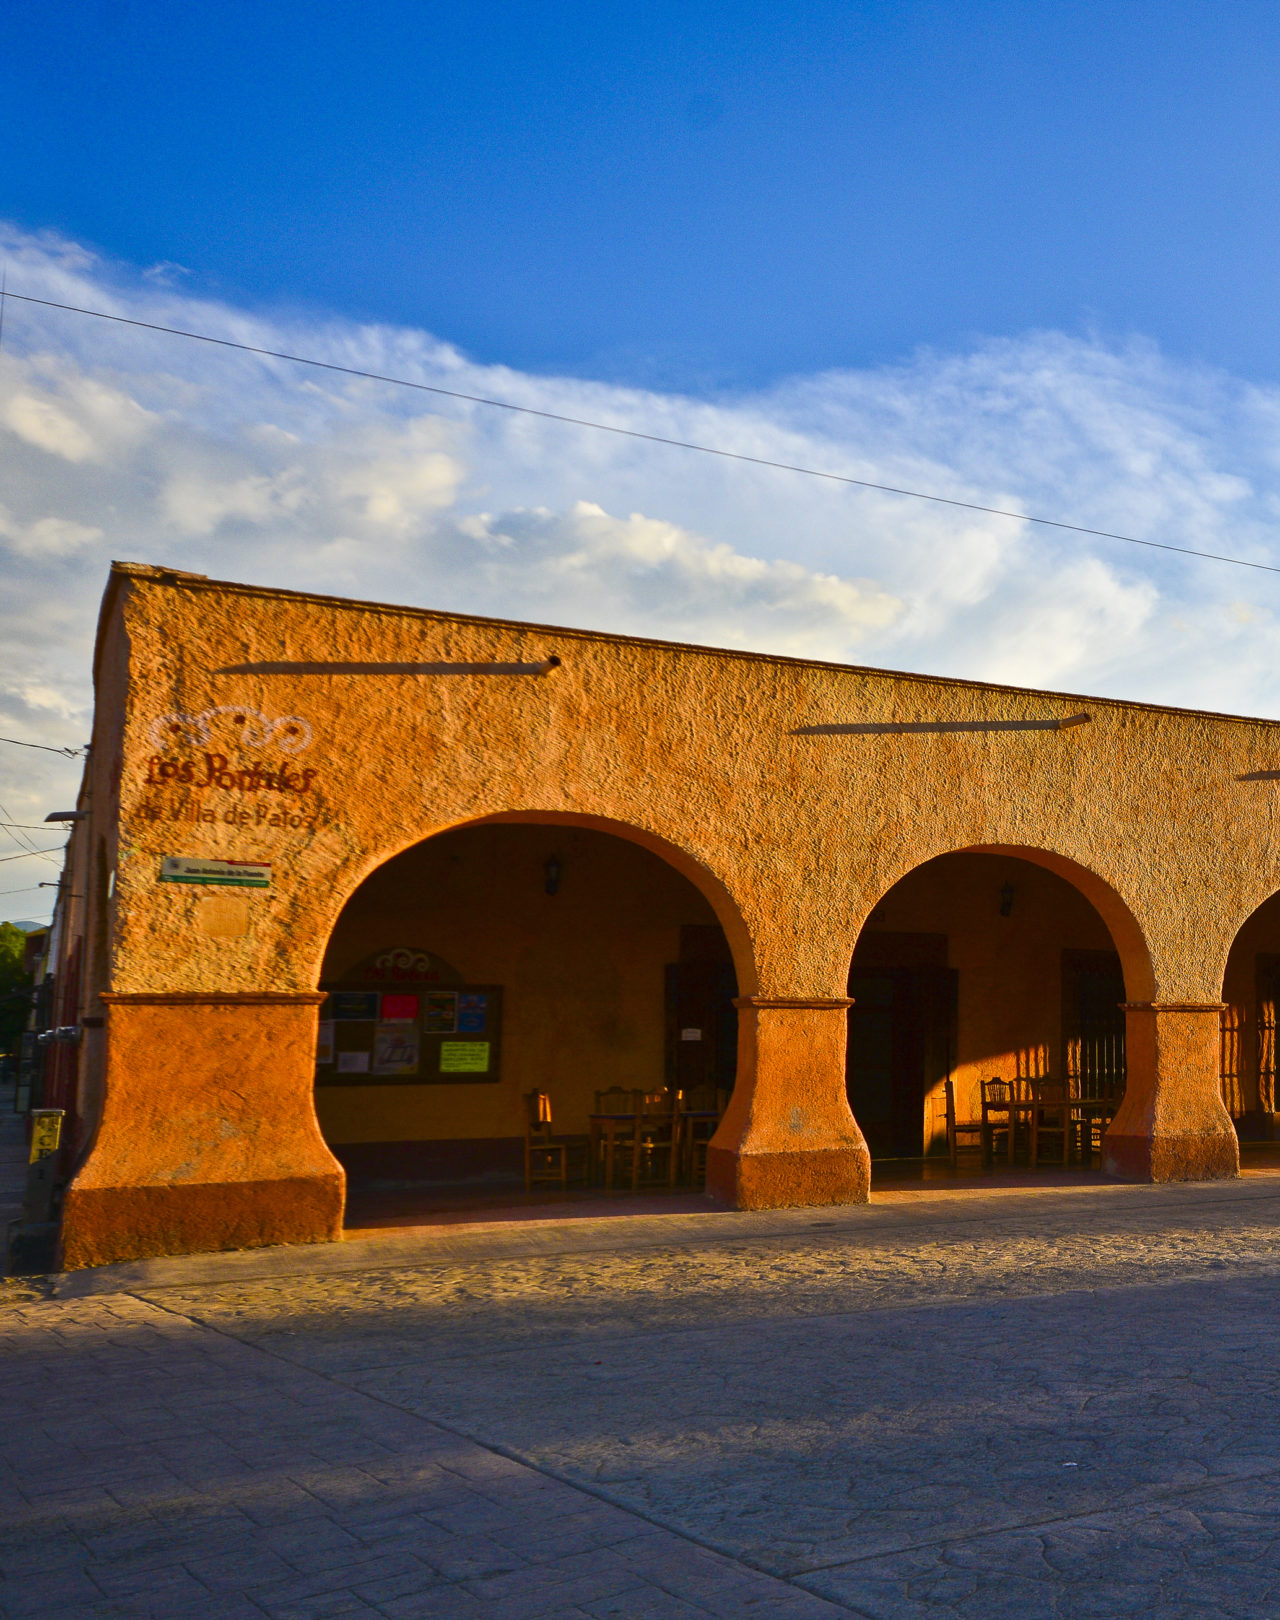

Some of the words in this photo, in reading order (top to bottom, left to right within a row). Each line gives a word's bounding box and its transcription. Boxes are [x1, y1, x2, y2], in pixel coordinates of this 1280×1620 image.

[144, 755, 196, 785] Los
[196, 753, 318, 793] Portales
[223, 803, 251, 826] de
[256, 804, 318, 829] Patos
